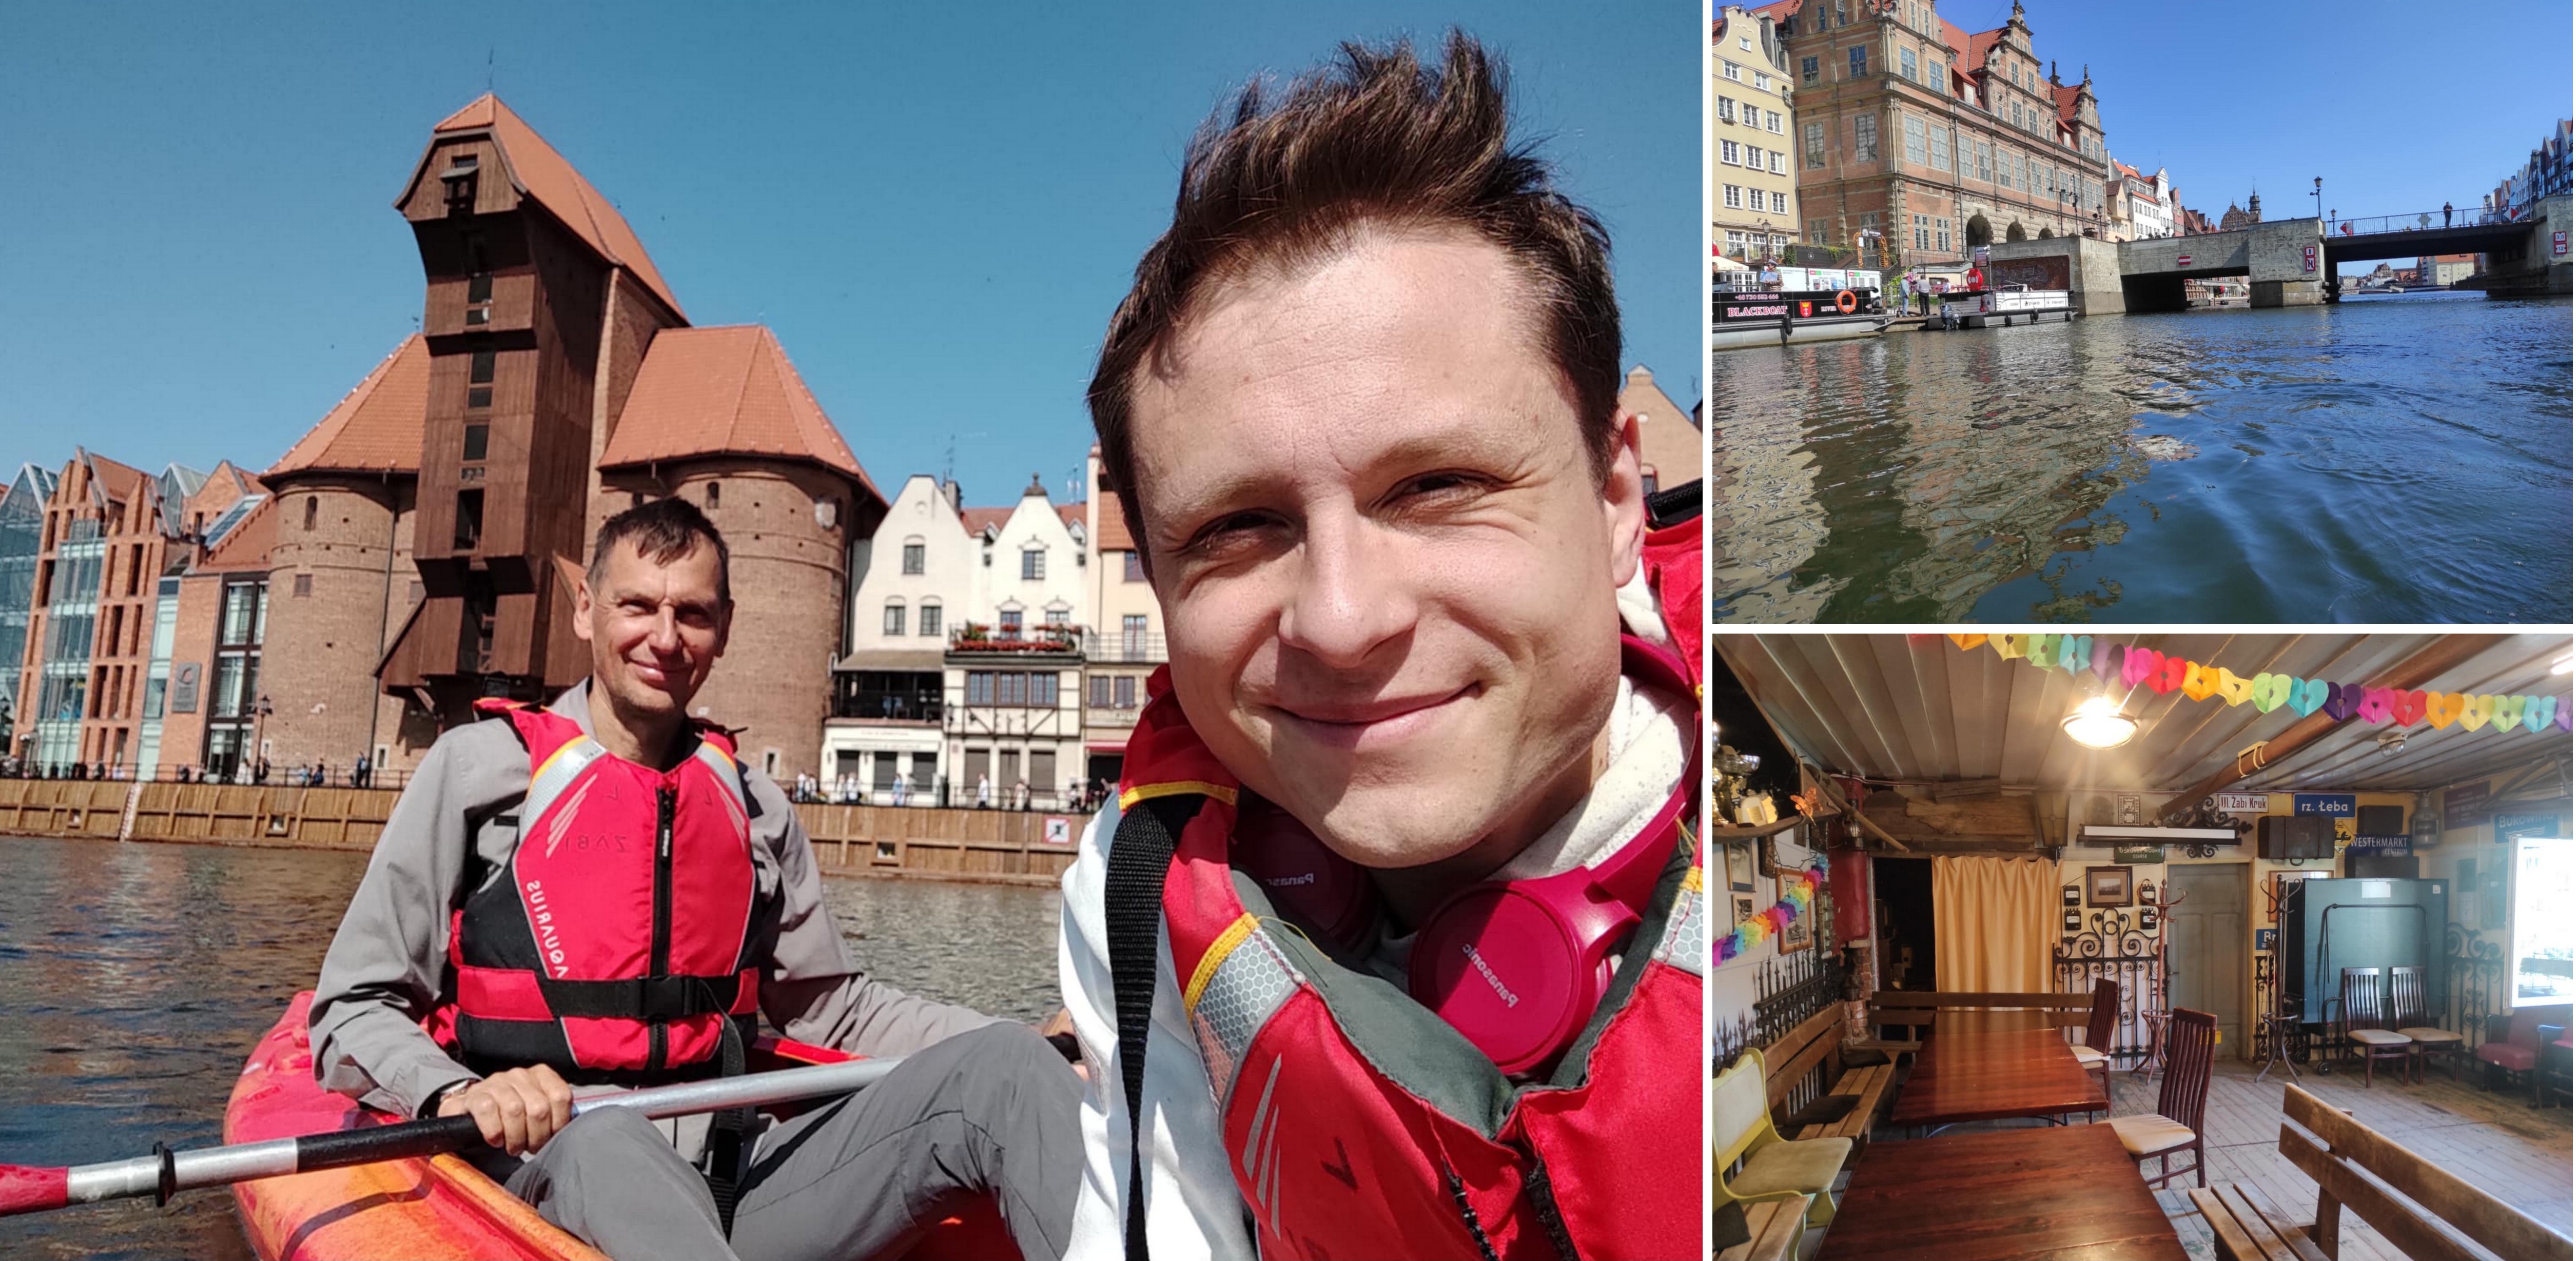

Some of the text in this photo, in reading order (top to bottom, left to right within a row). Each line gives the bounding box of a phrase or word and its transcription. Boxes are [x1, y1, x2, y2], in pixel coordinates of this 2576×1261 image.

[1728, 306, 1788, 317] BLACKBOAT
[2232, 795, 2247, 809] Żabi
[2249, 797, 2266, 809] Kruk
[2301, 800, 2348, 812] rz. Łeba
[2351, 837, 2408, 847] WESTERMARKT
